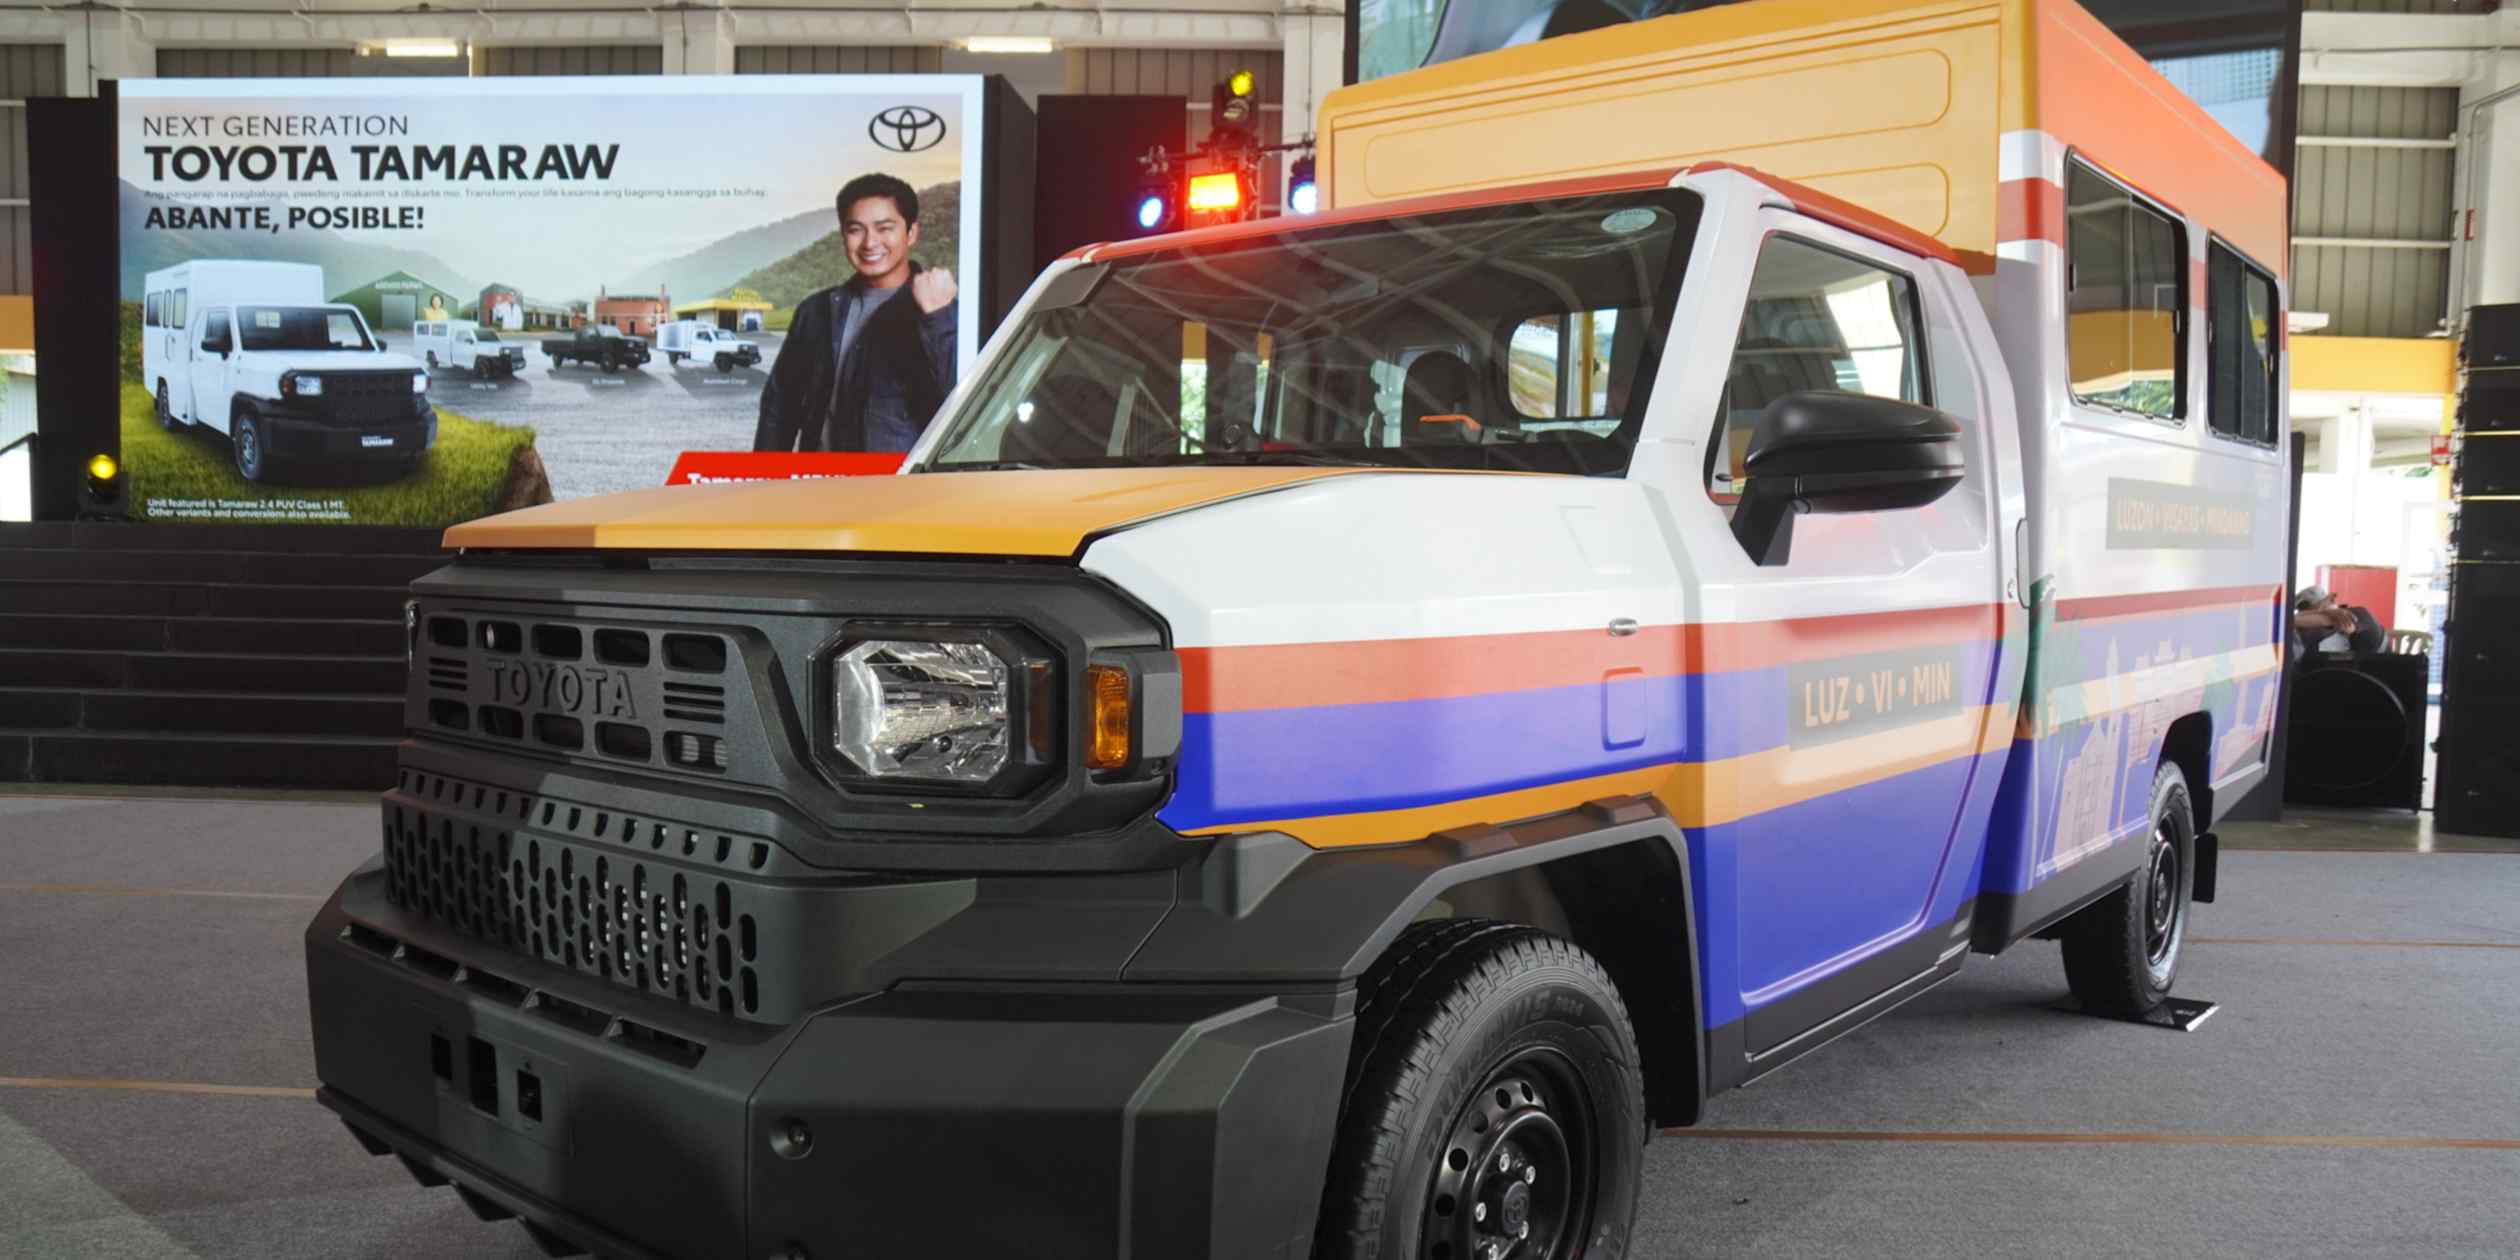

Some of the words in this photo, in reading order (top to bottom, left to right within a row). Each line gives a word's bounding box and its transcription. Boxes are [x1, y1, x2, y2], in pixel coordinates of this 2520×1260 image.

[143, 115, 214, 136] NEXT
[223, 115, 409, 136] GENERATION
[144, 144, 338, 182] TOYOTA
[350, 143, 620, 181] TAMARAW
[465, 188, 515, 197] Transform
[518, 189, 539, 198] your
[144, 206, 279, 233] ABANTE,
[288, 206, 424, 229] POSIBLE!
[147, 499, 166, 507] Unit
[276, 500, 295, 508] PUV
[297, 500, 321, 509] Class
[147, 508, 174, 517] Other
[213, 509, 231, 517] and
[486, 657, 637, 720] TOYOTA
[1805, 676, 1849, 727] LUZ
[1872, 670, 1893, 713] VI
[1912, 662, 1952, 706] MIN
